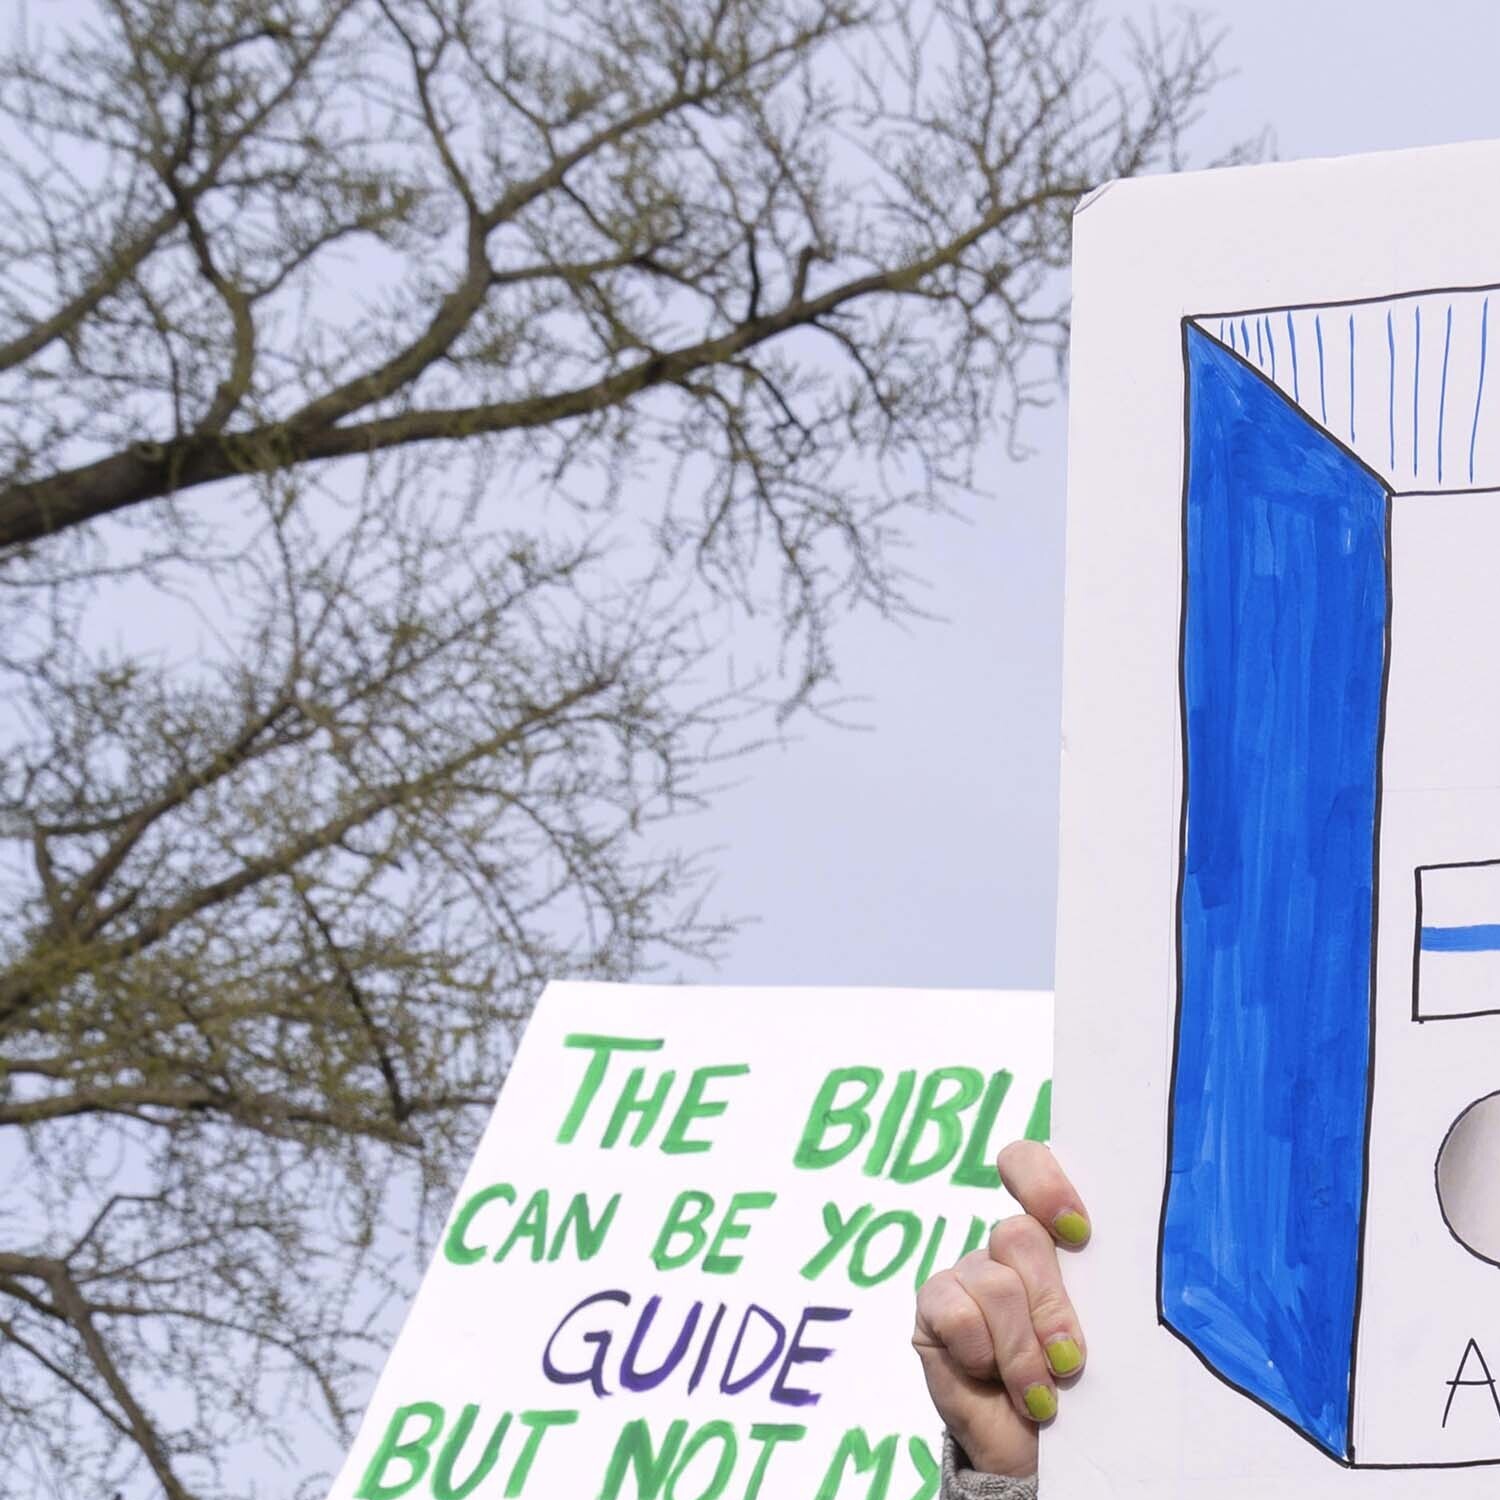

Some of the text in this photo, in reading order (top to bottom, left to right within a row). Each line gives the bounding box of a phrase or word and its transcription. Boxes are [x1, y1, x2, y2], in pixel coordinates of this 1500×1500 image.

[555, 1032, 750, 1155] THE
[443, 1183, 1000, 1295] CAN BE YOU
[542, 1288, 854, 1408] GUIDE
